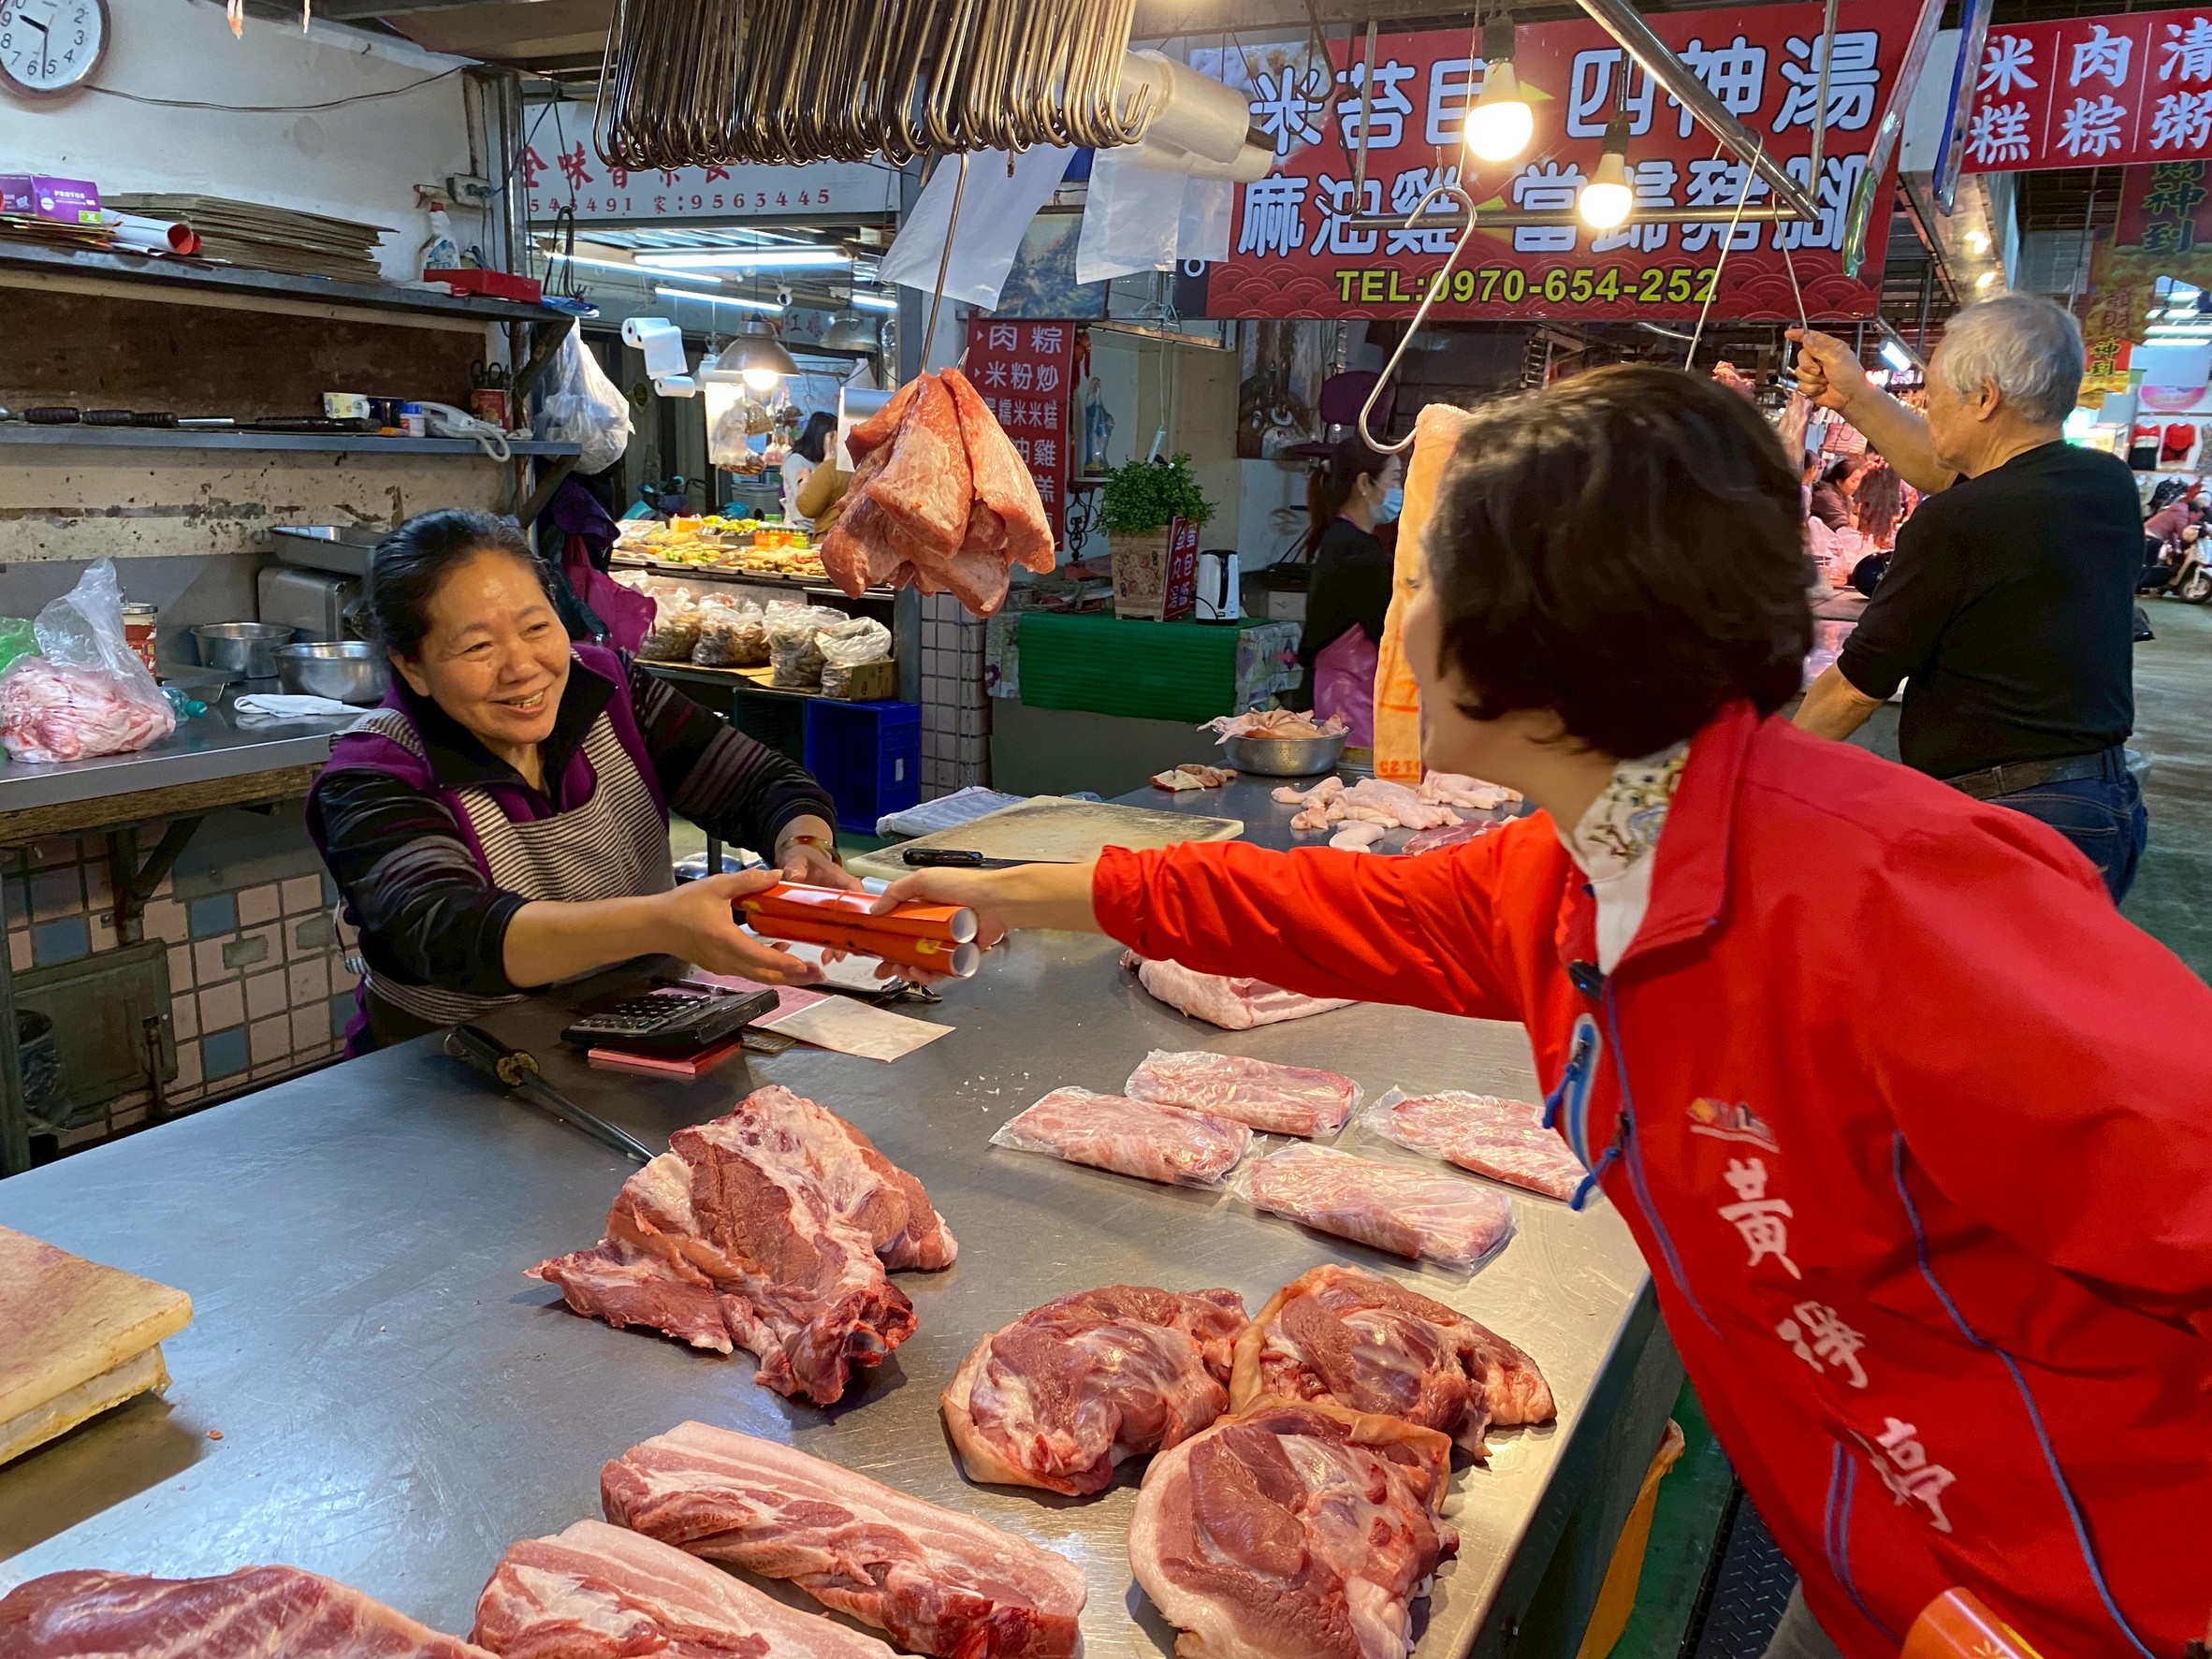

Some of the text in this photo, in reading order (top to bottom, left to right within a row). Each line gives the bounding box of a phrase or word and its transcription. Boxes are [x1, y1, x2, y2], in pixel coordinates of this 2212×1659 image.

[1, 11, 12, 27] 9
[74, 7, 85, 23] 2
[1, 33, 12, 49] 8
[74, 30, 84, 45] 3
[12, 51, 22, 65] 7
[64, 49, 74, 63] 4
[26, 60, 37, 76] 6
[46, 59, 57, 74] 5
[2056, 24, 2133, 157] 肉粽
[1965, 35, 2038, 165] 米糕
[984, 360, 1059, 392] 米粉炒
